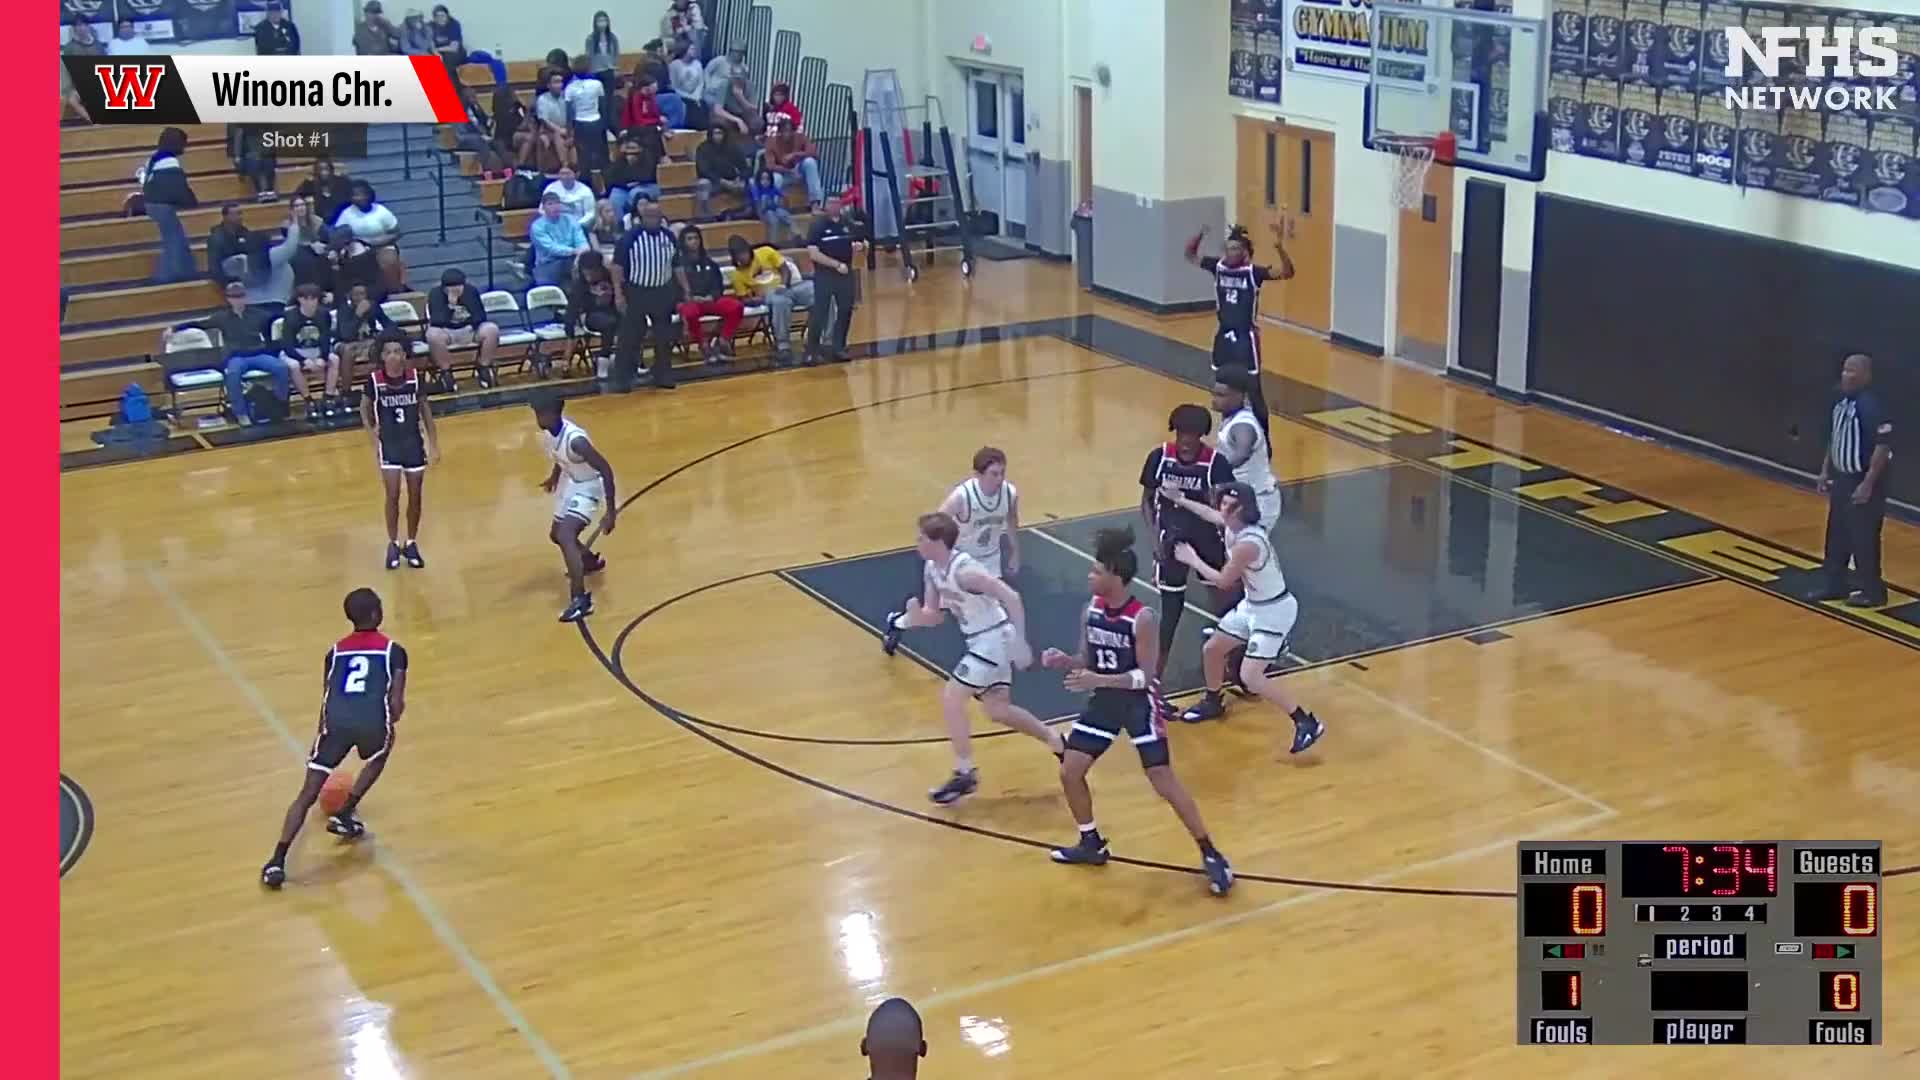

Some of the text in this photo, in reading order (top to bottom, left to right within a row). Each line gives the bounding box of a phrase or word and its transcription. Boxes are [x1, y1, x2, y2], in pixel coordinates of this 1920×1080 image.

[1293, 6, 1428, 55] GYMNAIUM
[380, 393, 418, 408] WINONA
[395, 407, 405, 423] 3
[1096, 648, 1118, 669] 13
[344, 655, 369, 693] 2
